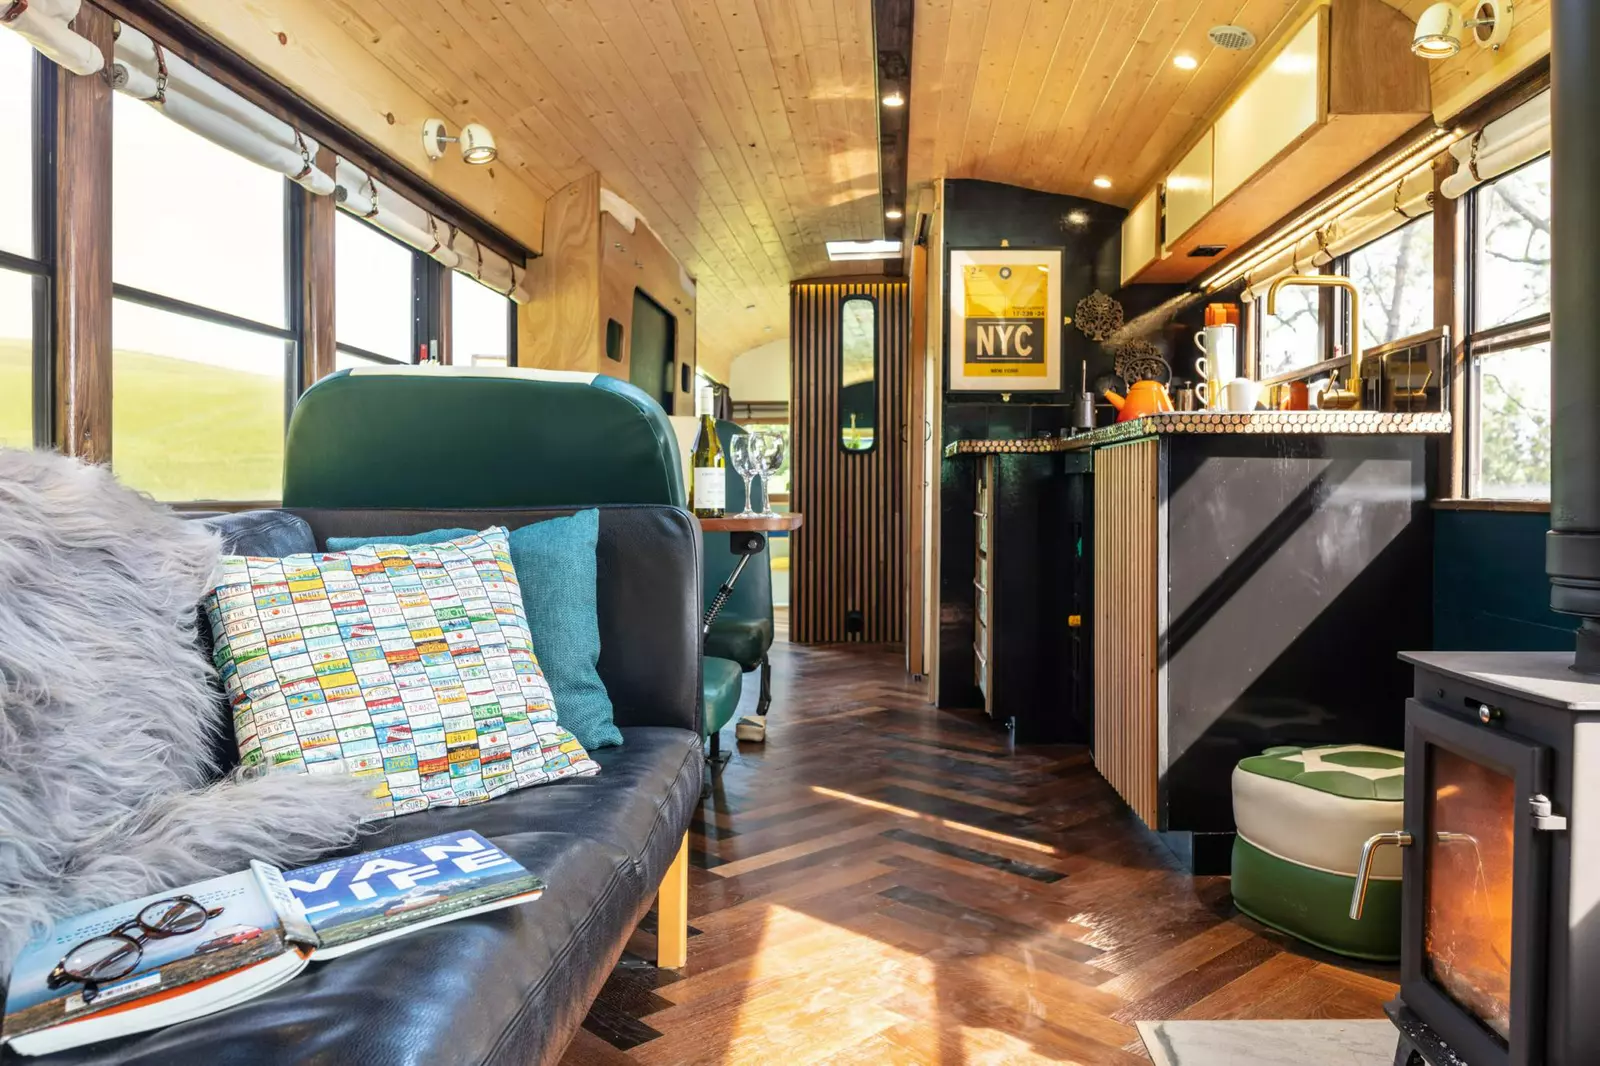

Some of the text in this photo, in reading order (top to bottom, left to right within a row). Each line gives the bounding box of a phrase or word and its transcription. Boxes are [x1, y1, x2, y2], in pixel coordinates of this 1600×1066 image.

[976, 325, 1033, 356] NYC
[286, 837, 485, 893] VAN
[295, 849, 512, 914] LIFE
